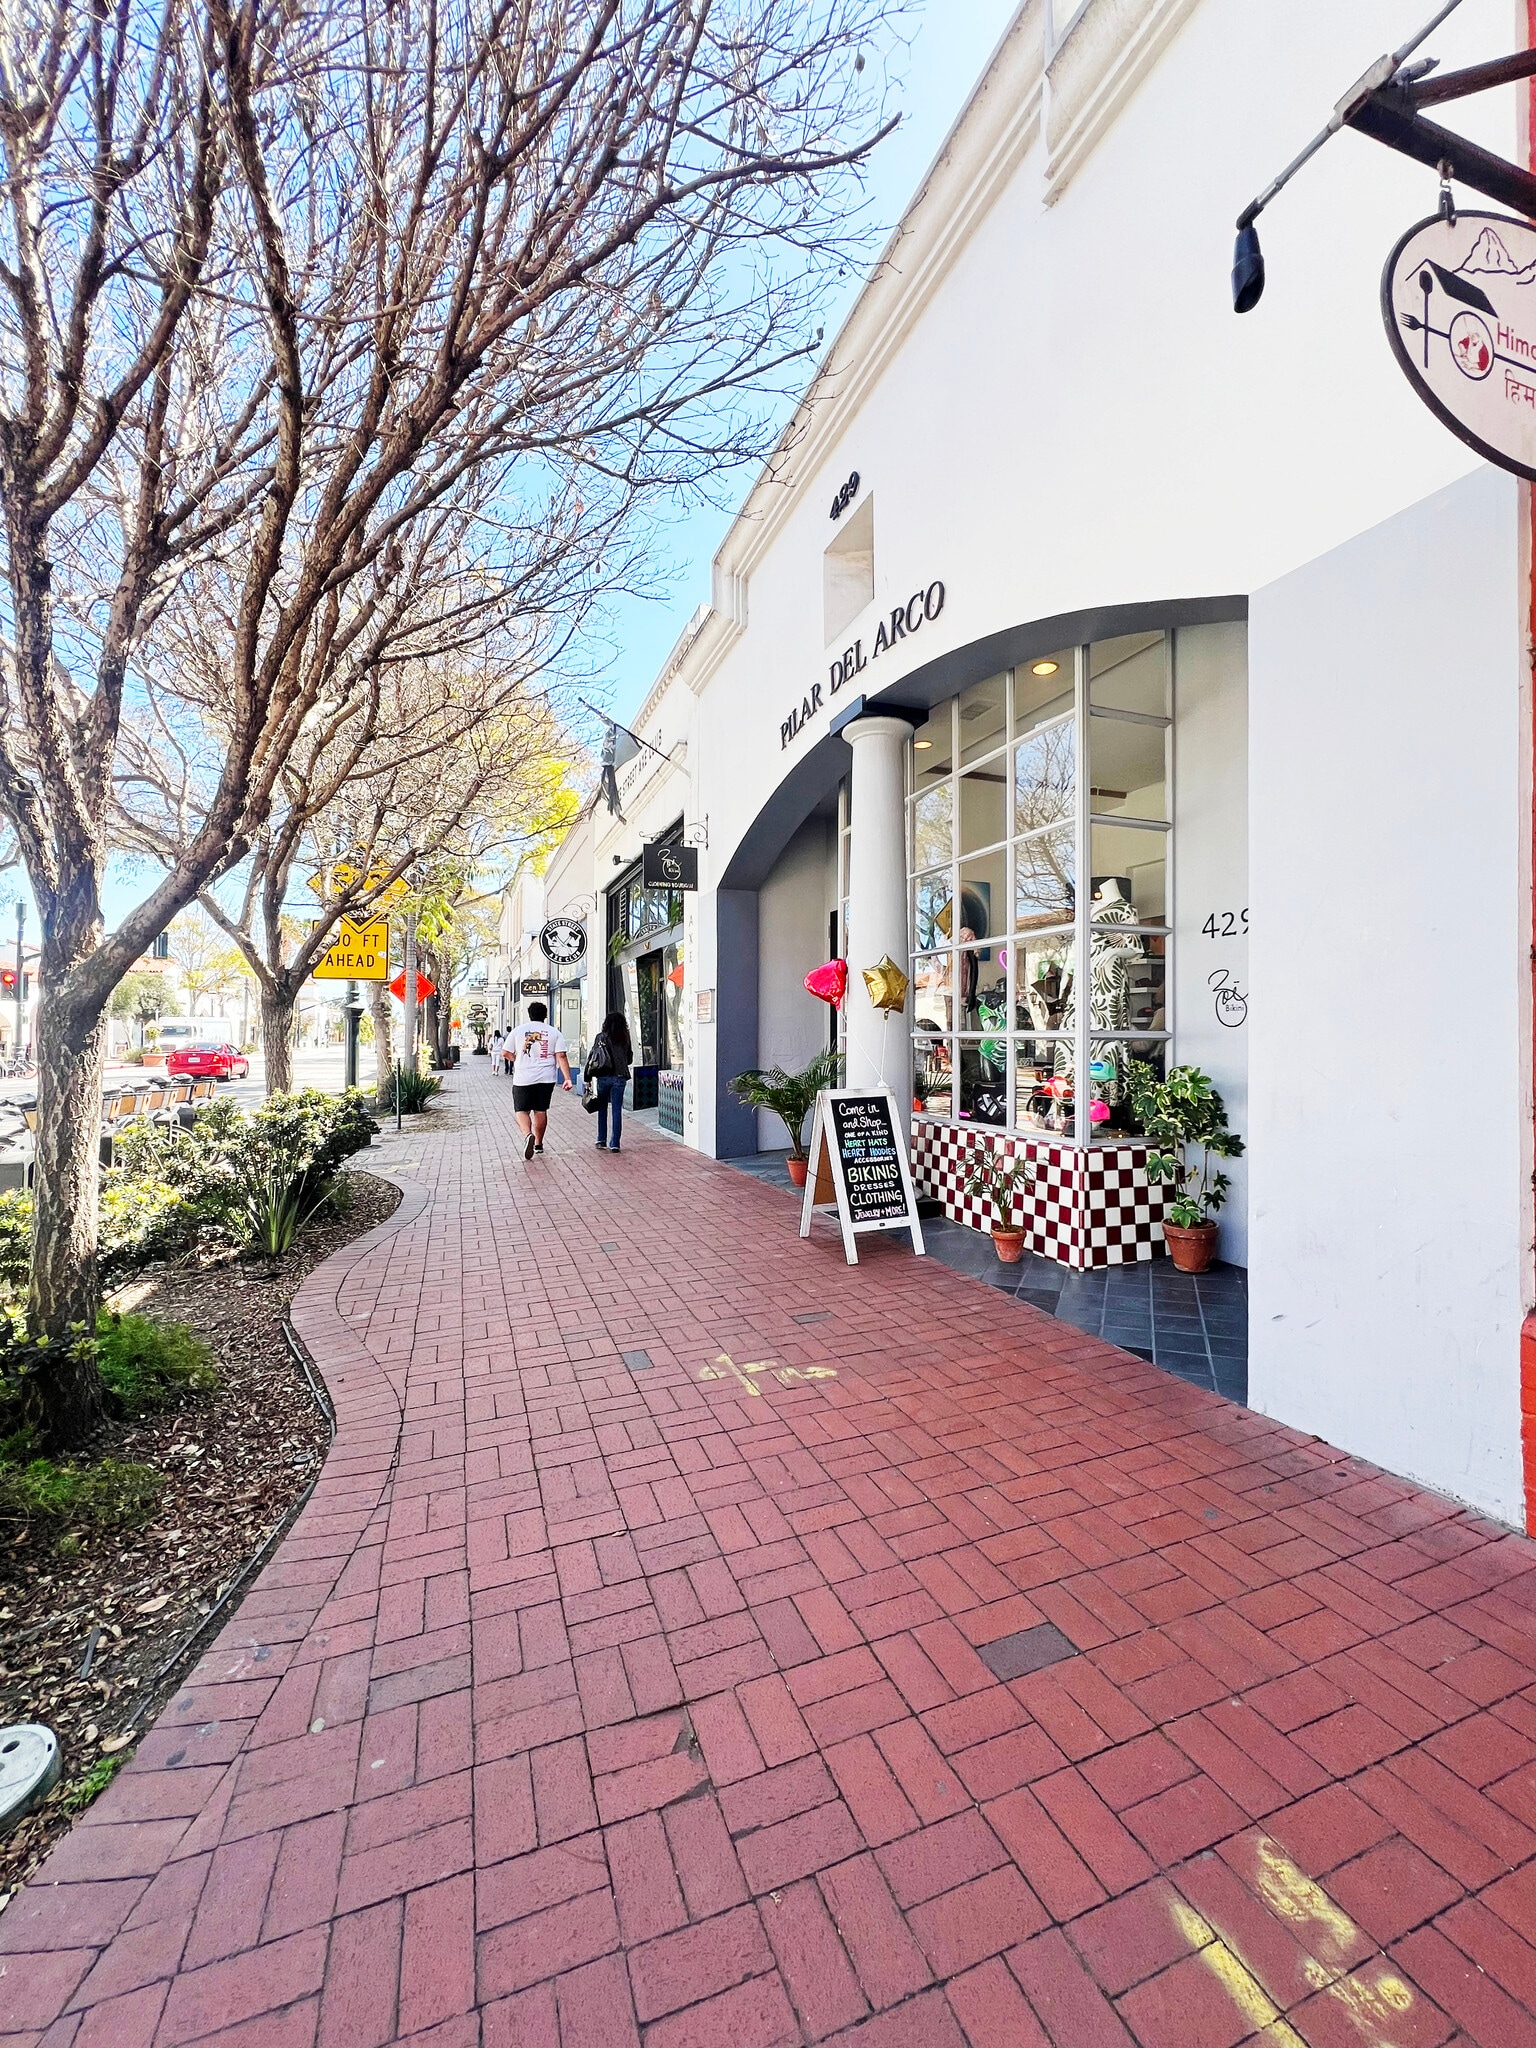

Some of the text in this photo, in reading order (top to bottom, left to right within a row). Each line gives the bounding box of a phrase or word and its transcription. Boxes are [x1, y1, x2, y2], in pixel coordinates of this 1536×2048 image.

[829, 470, 860, 520] 429
[779, 580, 945, 751] PILAR DEL ARCO
[363, 934, 380, 947] FT
[325, 953, 375, 968] AHEAD
[564, 950, 581, 962] CLUB
[523, 982, 537, 992] Zen
[1225, 1003, 1245, 1012] Bikini
[838, 1102, 880, 1116] Come in
[842, 1117, 860, 1129] and
[844, 1138, 888, 1149] HEART HATS
[841, 1148, 866, 1159] HEART
[847, 1163, 899, 1183] BIKINIS
[853, 1180, 895, 1192] DRESSES
[850, 1189, 903, 1207] CLOTHING
